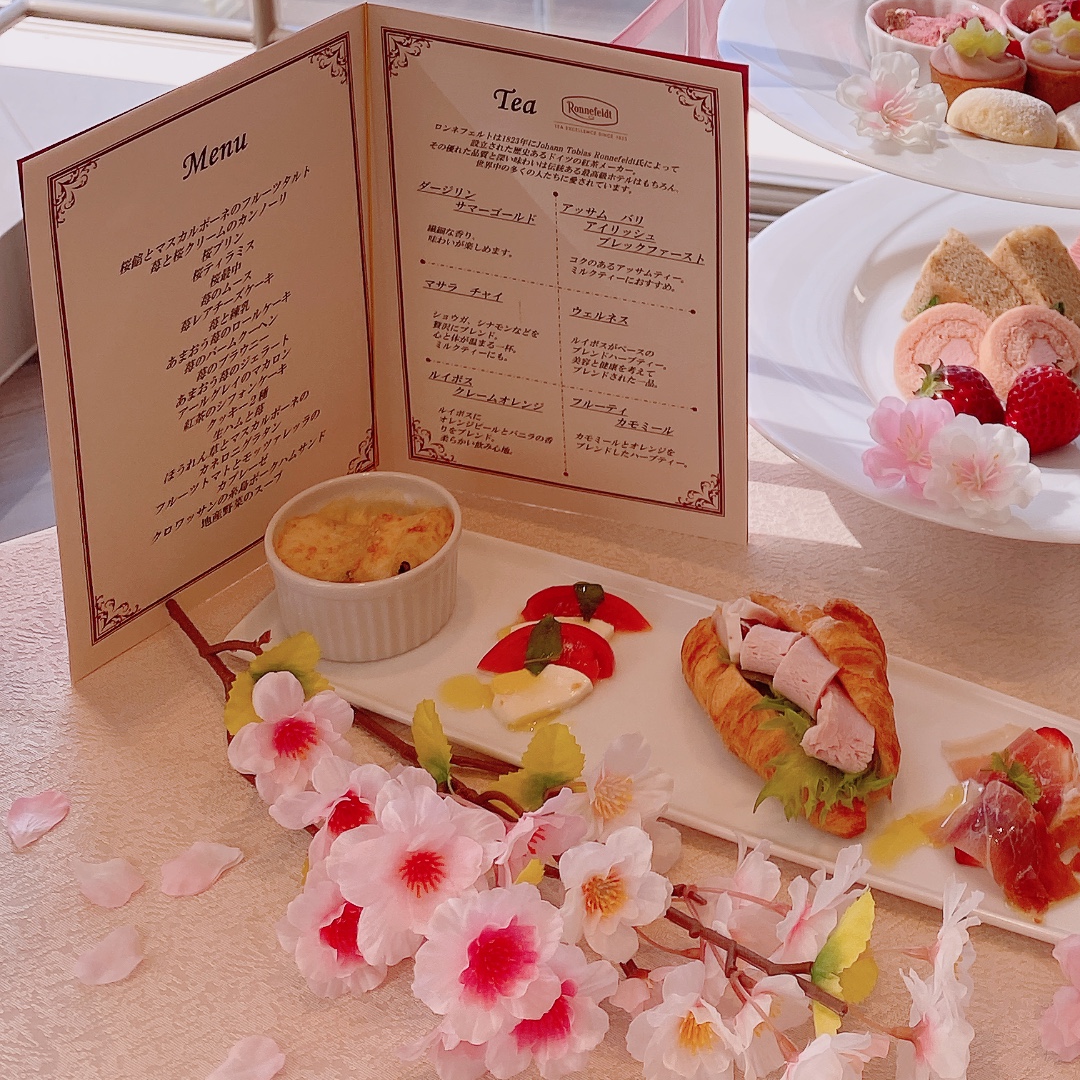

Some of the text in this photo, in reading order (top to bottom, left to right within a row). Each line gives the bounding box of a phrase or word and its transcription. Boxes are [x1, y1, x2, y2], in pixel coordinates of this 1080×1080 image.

[493, 88, 538, 115] Tea
[566, 100, 613, 120] Ronnefeldt
[182, 132, 248, 180] Menu
[566, 146, 592, 157] Tobias
[419, 181, 477, 199] ダージリン
[455, 201, 537, 224] サマーゴールド
[562, 203, 608, 220] アッサム
[150, 191, 288, 274] 苺と桜クリームのカンノーリ
[585, 221, 657, 241] アイリッシュ
[202, 232, 244, 262] 桜プリン
[599, 237, 705, 264] ブレックファースト
[192, 240, 255, 283] 桜ティラミス
[210, 261, 242, 287] 桜最中
[569, 256, 684, 283] コクのあるアッサムティー。
[200, 270, 252, 307] 苺のムース
[425, 280, 503, 301] マサラ チャイ
[571, 266, 675, 292] ミルクティーにおすすめ。
[180, 272, 275, 333] 苺レアチーズケーキ
[208, 299, 250, 333] 苺と練乳
[571, 306, 629, 325] ウェルネス
[166, 291, 291, 370] あまおう苺のロールケーキ
[183, 314, 278, 374] 苺のバームクーヘン
[195, 335, 270, 382] 苺のブラウニー
[436, 341, 508, 362] ミルクティーにも。
[571, 337, 655, 357] ルイボスがベースの
[175, 333, 289, 408] あまおう苺のジェラート
[178, 347, 292, 420] アールグレイのマカロン
[428, 371, 474, 387] ルイボス
[183, 363, 288, 432] 紅茶のシフォンケーキ
[207, 385, 269, 432] クッキー2種
[454, 386, 544, 411] クレームオレンジ
[572, 397, 628, 416] フルーティ
[213, 402, 265, 442] 生ハムと苺
[438, 406, 482, 421] ルイボスに
[616, 417, 674, 435] カモミール
[199, 421, 281, 477] カネロニグラタン
[575, 432, 676, 457] カモミールとオレンジを
[200, 470, 283, 529] 地産野菜のスープ
